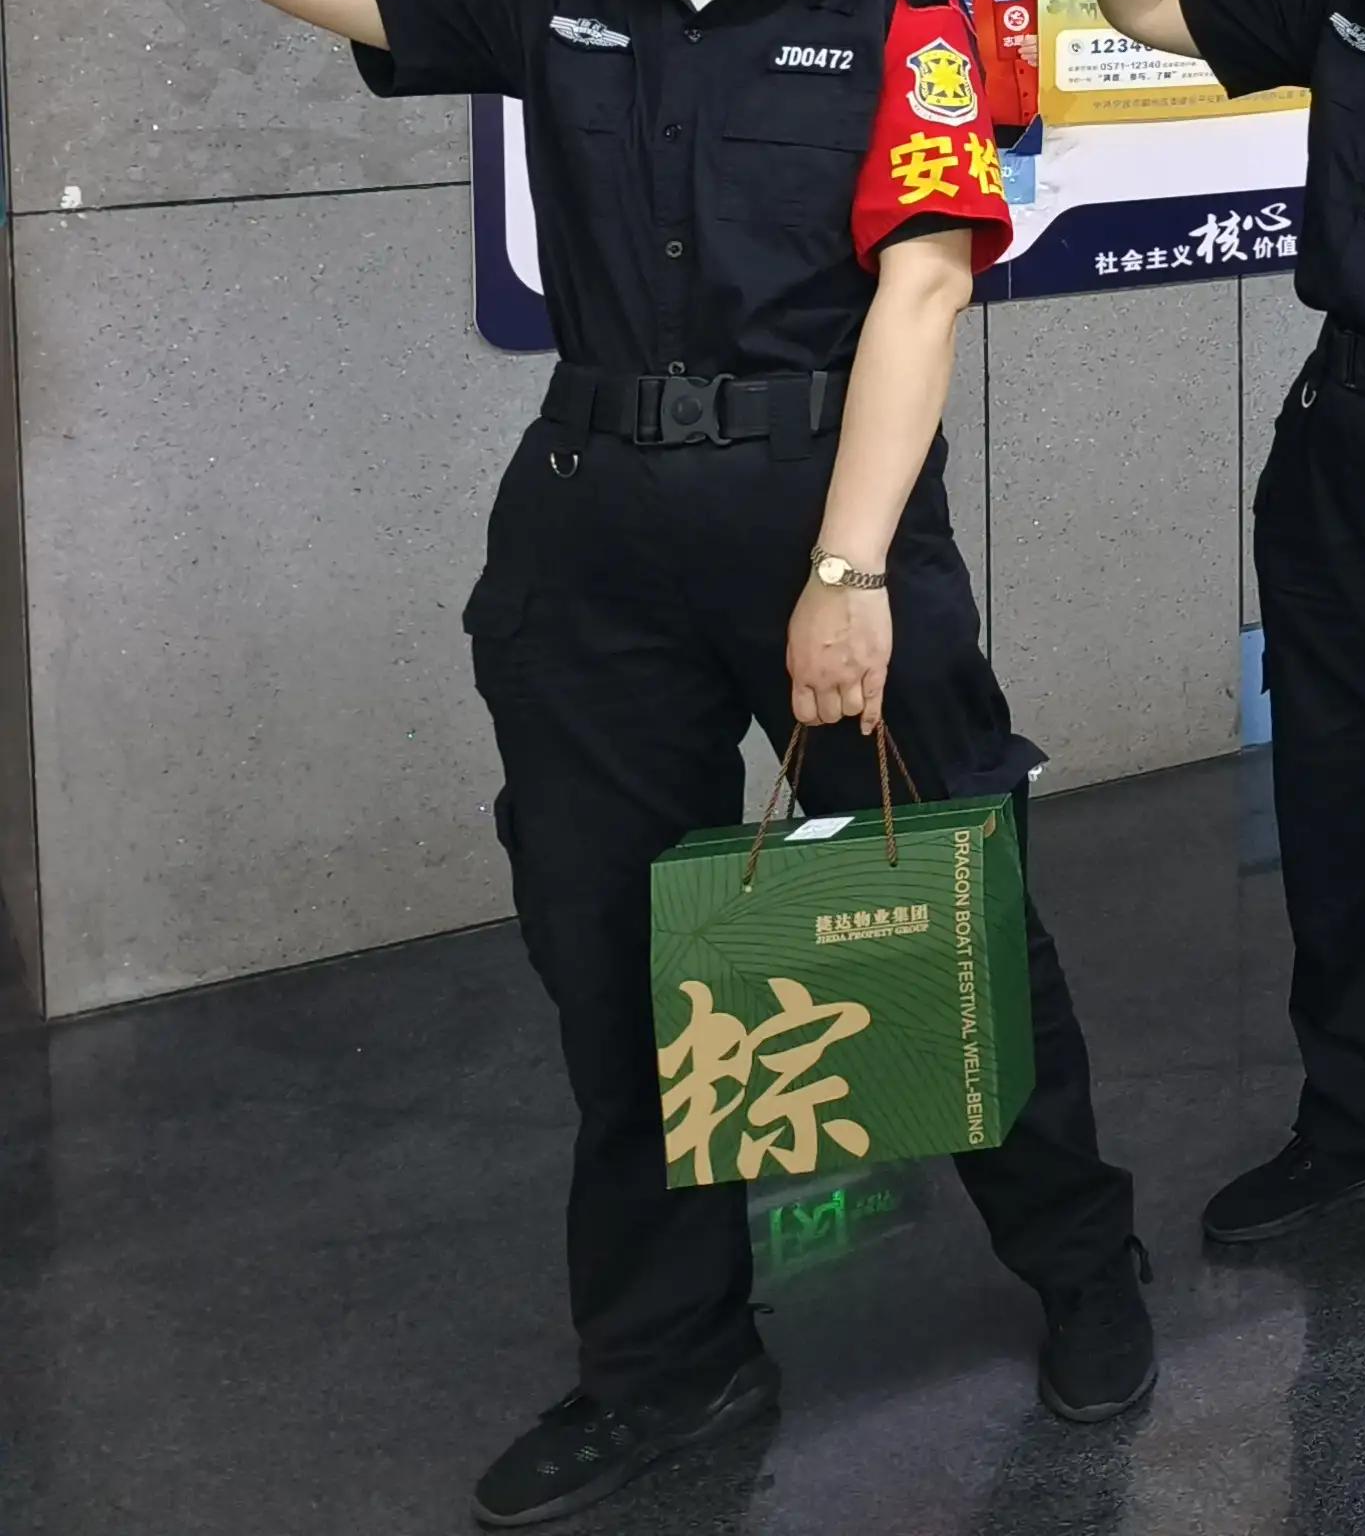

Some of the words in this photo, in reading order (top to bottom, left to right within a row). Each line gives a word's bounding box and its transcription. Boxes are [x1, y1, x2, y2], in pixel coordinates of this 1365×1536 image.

[774, 46, 854, 71] JD0472
[954, 830, 971, 906] DRAGON
[955, 910, 973, 957] BOAT
[957, 960, 978, 1040] FESTIVAL
[656, 977, 872, 1186] 粽
[963, 1041, 985, 1146] WELL-BEING
